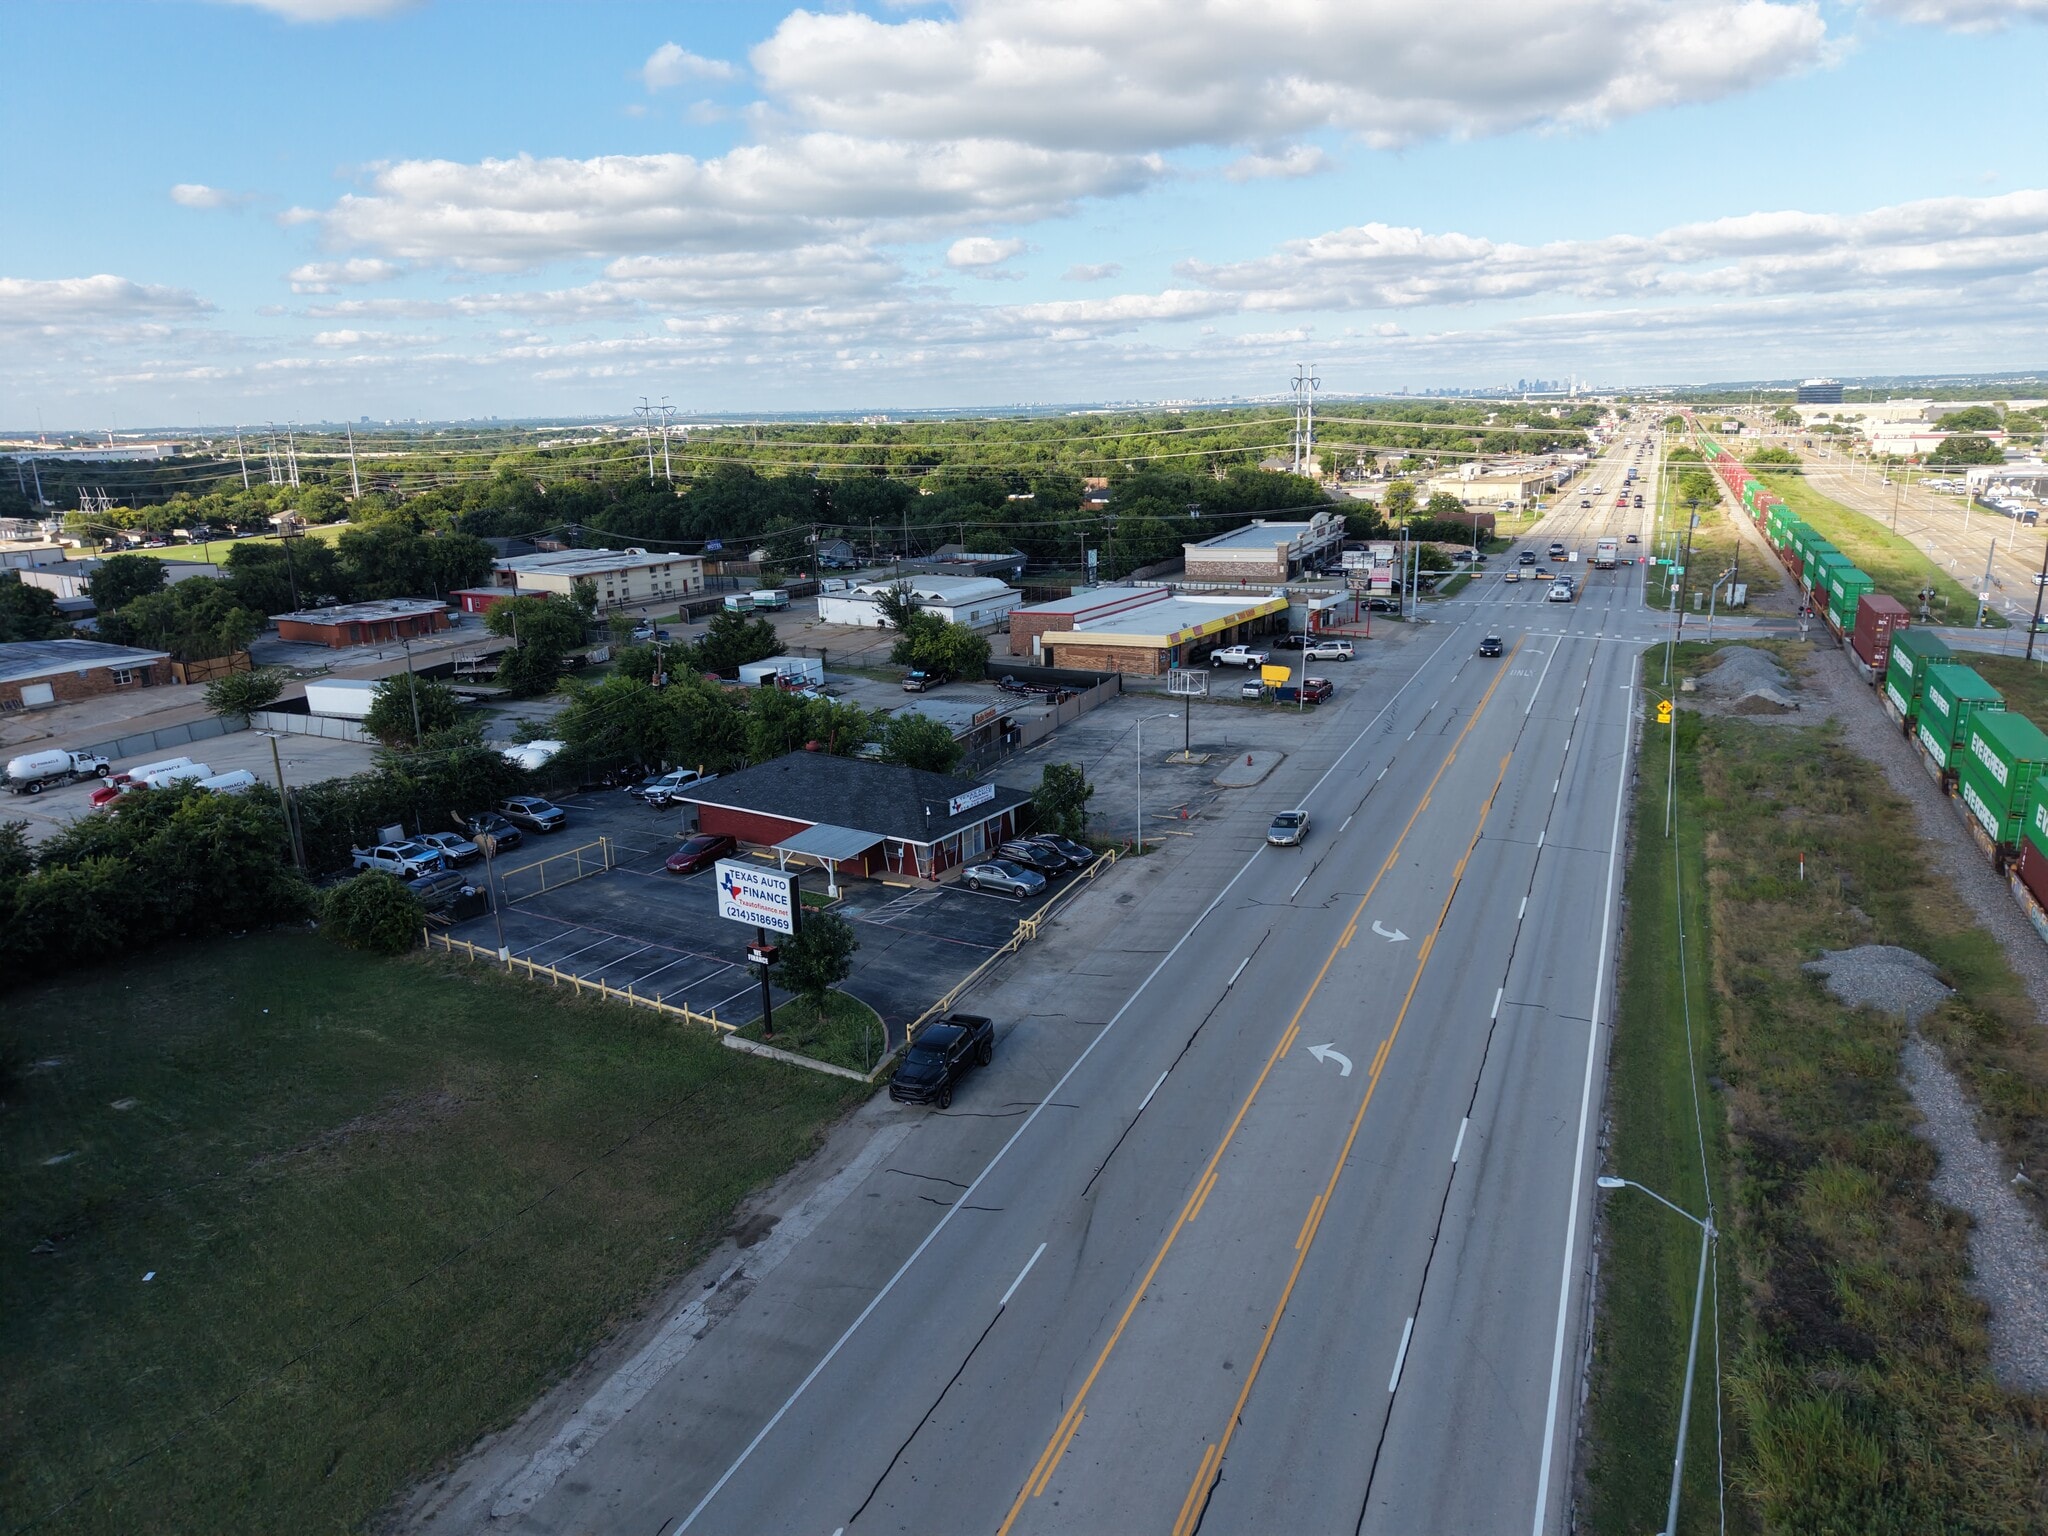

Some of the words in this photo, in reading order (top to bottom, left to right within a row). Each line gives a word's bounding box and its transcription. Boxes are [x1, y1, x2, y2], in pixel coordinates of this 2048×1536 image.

[1971, 731, 2009, 788] EVERGREEN
[221, 780, 247, 791] PINNACLE
[1963, 781, 1999, 842] EVERGREEN
[729, 869, 758, 884] TEXAS
[761, 877, 787, 890] AUTO
[743, 886, 788, 906] FINANCE
[739, 899, 789, 916] Txautofinance.net
[727, 906, 789, 930] (214)5186969
[747, 953, 769, 965] FINANCE
